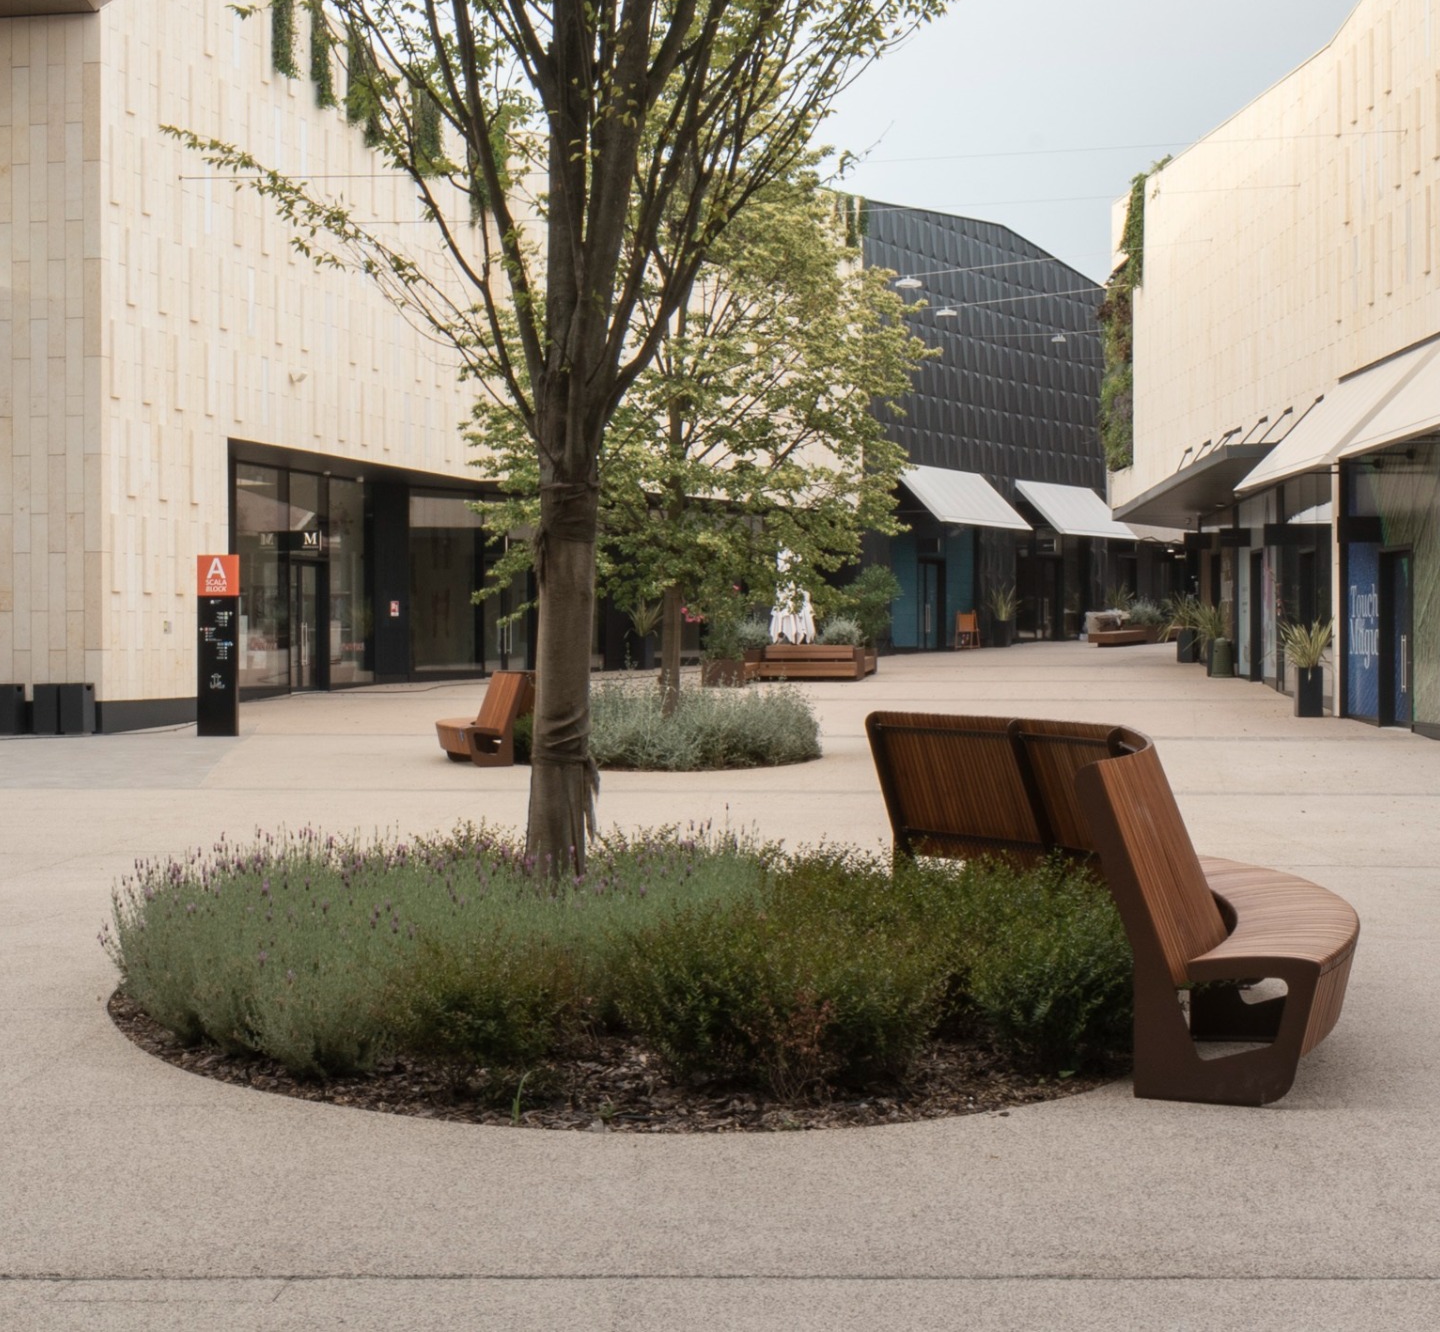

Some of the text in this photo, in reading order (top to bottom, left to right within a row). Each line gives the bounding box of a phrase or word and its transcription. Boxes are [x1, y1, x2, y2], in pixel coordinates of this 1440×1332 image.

[304, 532, 317, 544] M
[206, 557, 226, 578] A
[1350, 584, 1379, 618] Touch
